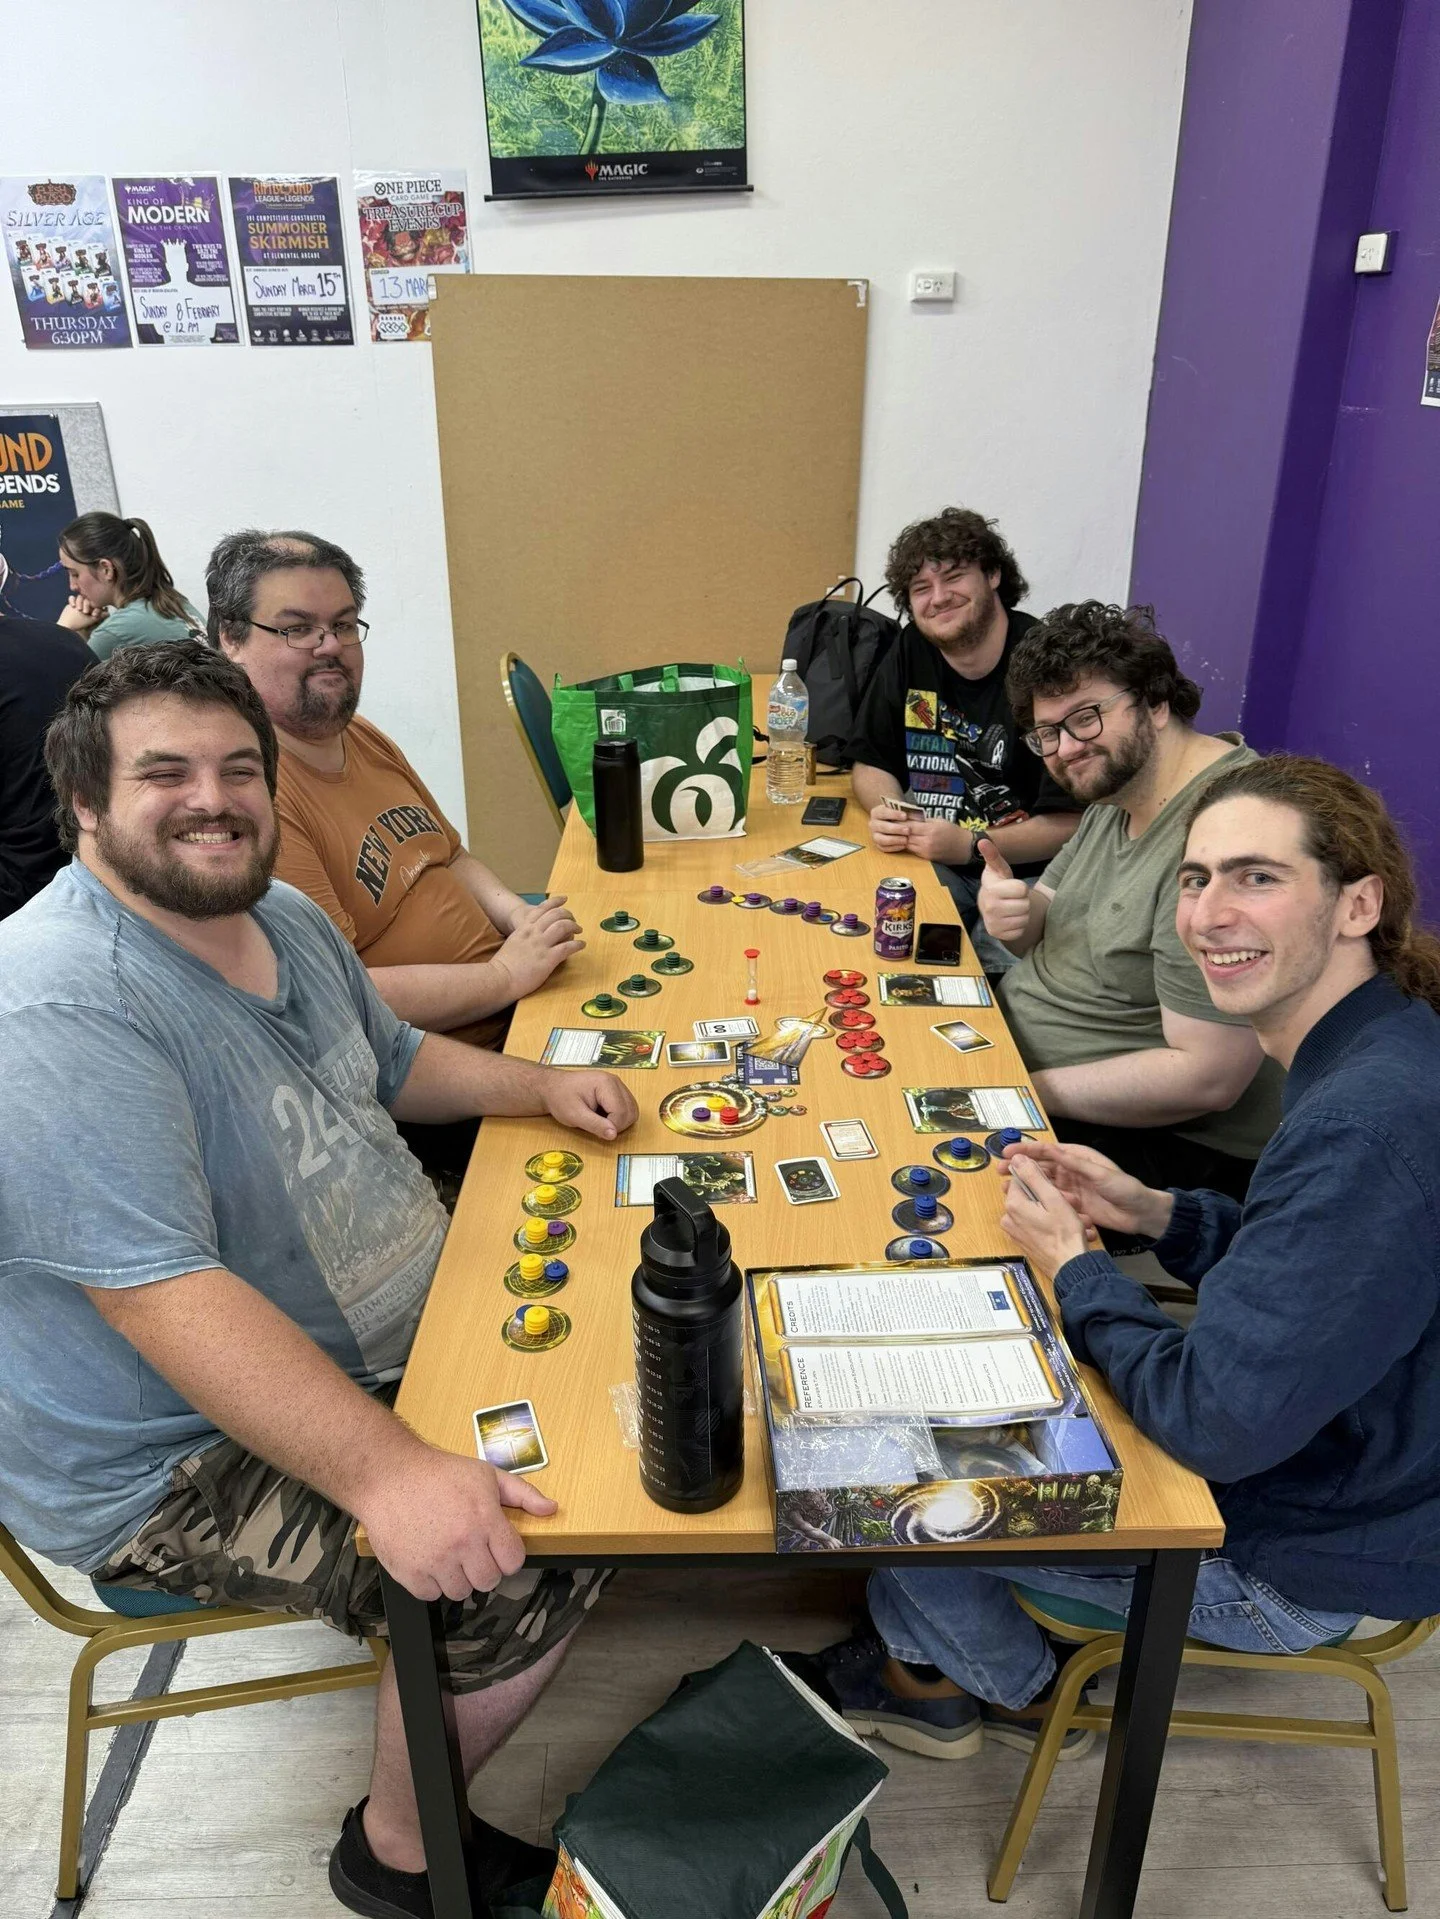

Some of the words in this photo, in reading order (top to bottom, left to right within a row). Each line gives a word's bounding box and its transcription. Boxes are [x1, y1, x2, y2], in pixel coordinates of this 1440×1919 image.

[599, 164, 648, 176] MAGIC
[374, 182, 403, 195] ONE
[406, 180, 442, 194] PIECE
[127, 198, 149, 206] KING
[153, 198, 165, 206] OF
[7, 210, 66, 226] SILVER
[69, 209, 105, 225] AGE
[128, 206, 210, 224] MODERN
[363, 204, 434, 220] TREASURE
[434, 202, 464, 216] CUP
[247, 222, 327, 234] SUMMONER
[389, 216, 441, 231] EVENTS
[250, 235, 330, 249] SKIRMISH
[379, 276, 403, 298] 13
[405, 277, 429, 297] MAR
[177, 302, 183, 321] 8
[31, 316, 118, 330] THURSDAY
[163, 321, 171, 333] @
[176, 323, 185, 333] 12
[188, 322, 199, 332] PM
[51, 330, 103, 344] 6:30PM
[0, 499, 25, 509] AME
[355, 825, 393, 907] NEW
[375, 805, 444, 845] YORK
[885, 922, 913, 931] KIRKS
[272, 1084, 364, 1179] 24
[789, 1300, 799, 1334] CREDITS
[797, 1357, 812, 1409] REFERENCE
